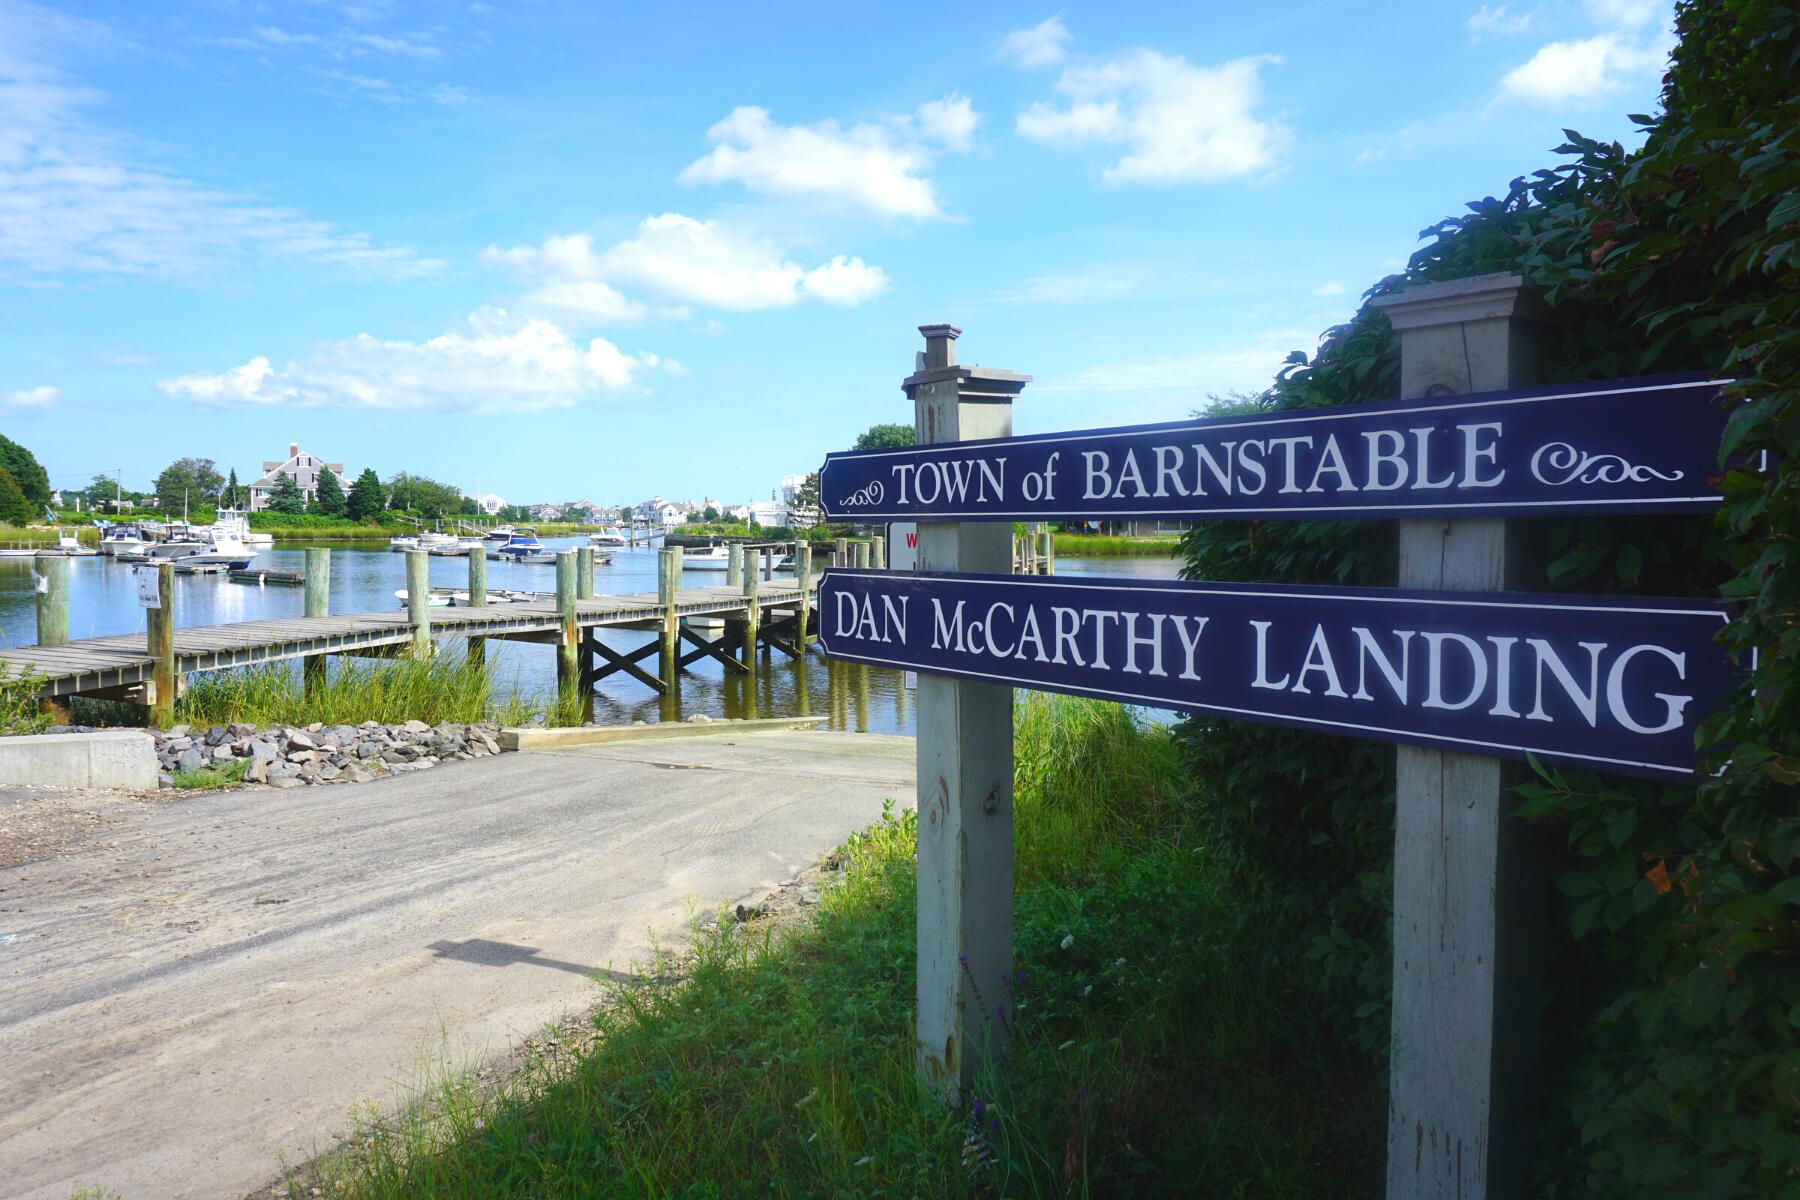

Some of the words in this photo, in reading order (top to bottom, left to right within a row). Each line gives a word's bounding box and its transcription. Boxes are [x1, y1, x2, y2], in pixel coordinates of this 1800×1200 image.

[891, 457, 1007, 505] TOWN
[1022, 451, 1060, 501] of
[1081, 422, 1506, 500] BARNSTABLE
[834, 591, 909, 646] DAN
[931, 597, 1210, 681] McCARTHY
[1249, 620, 1694, 734] LANDING
